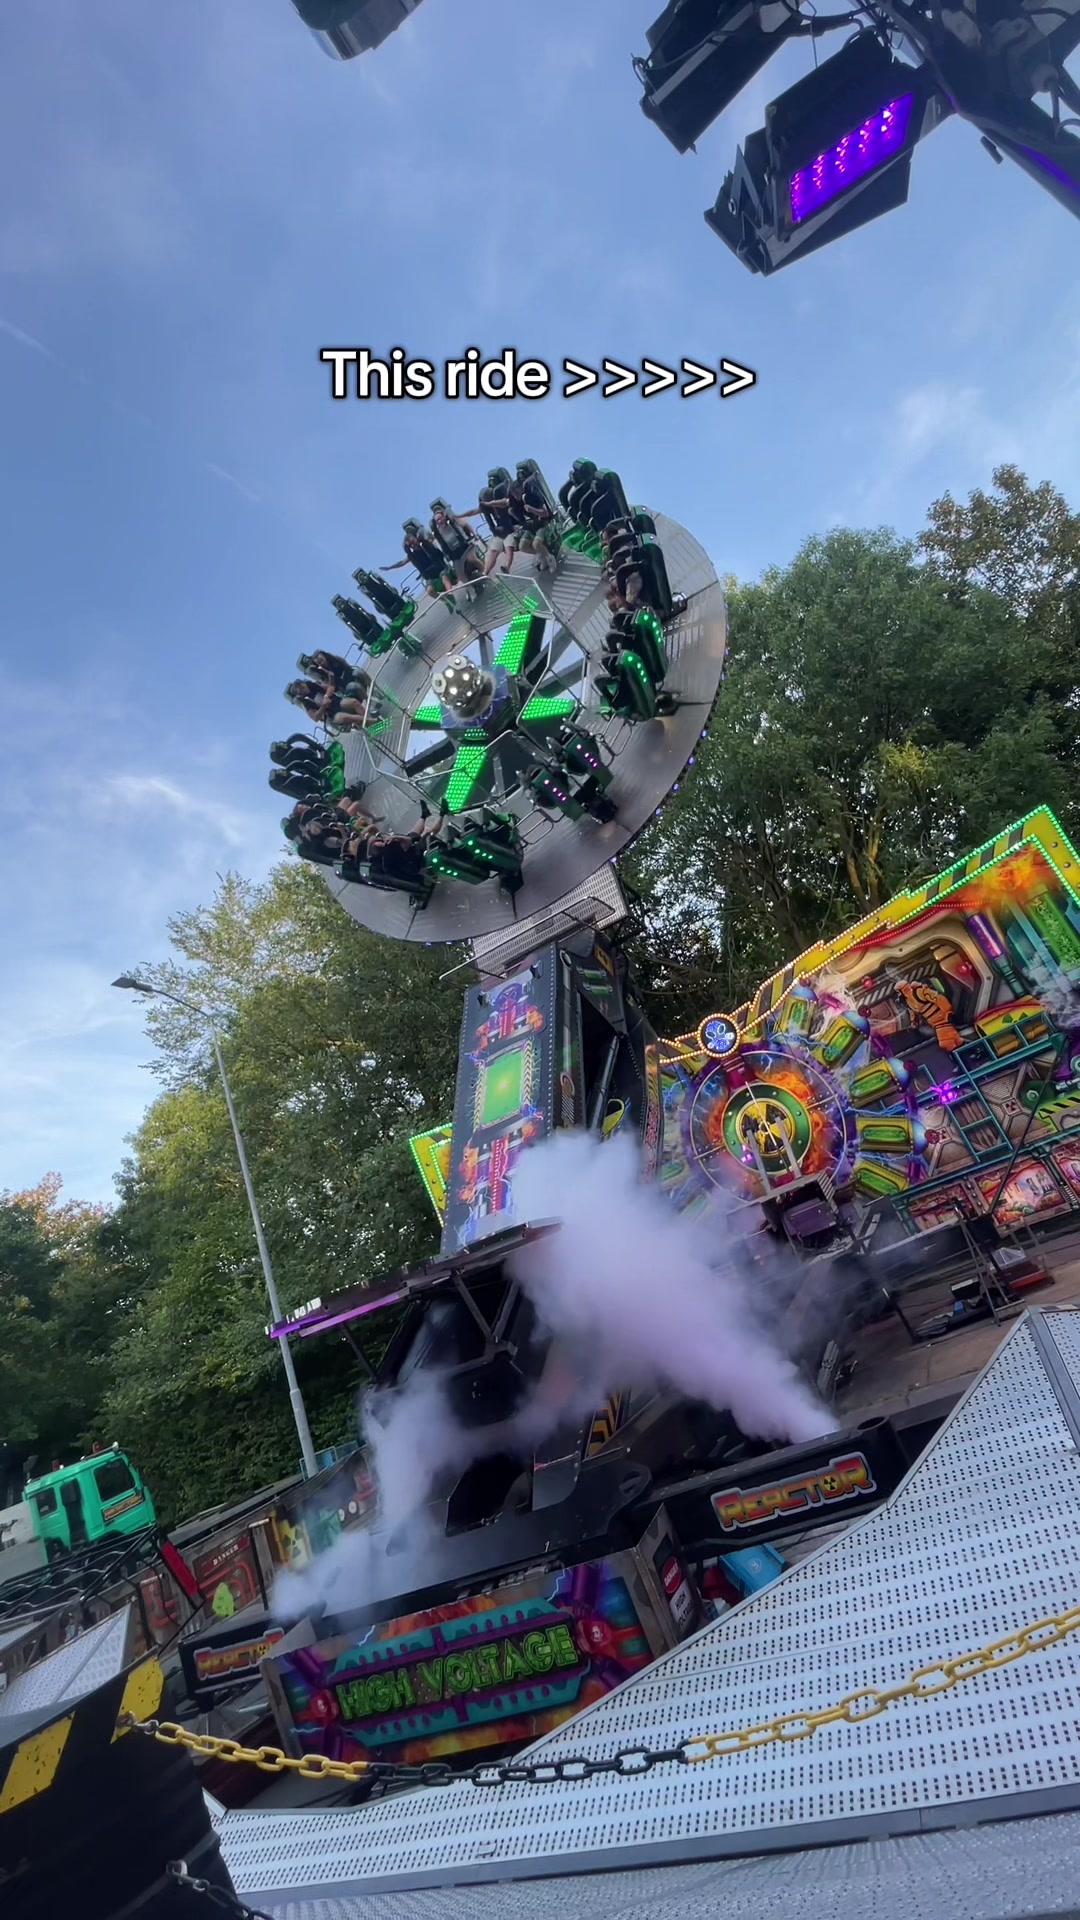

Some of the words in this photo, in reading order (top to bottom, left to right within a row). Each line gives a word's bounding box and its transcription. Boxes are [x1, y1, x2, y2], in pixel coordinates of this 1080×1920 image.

[713, 1454, 873, 1529] REACTOR
[336, 1667, 415, 1720] HIGH
[417, 1624, 578, 1699] VOLTAGE
